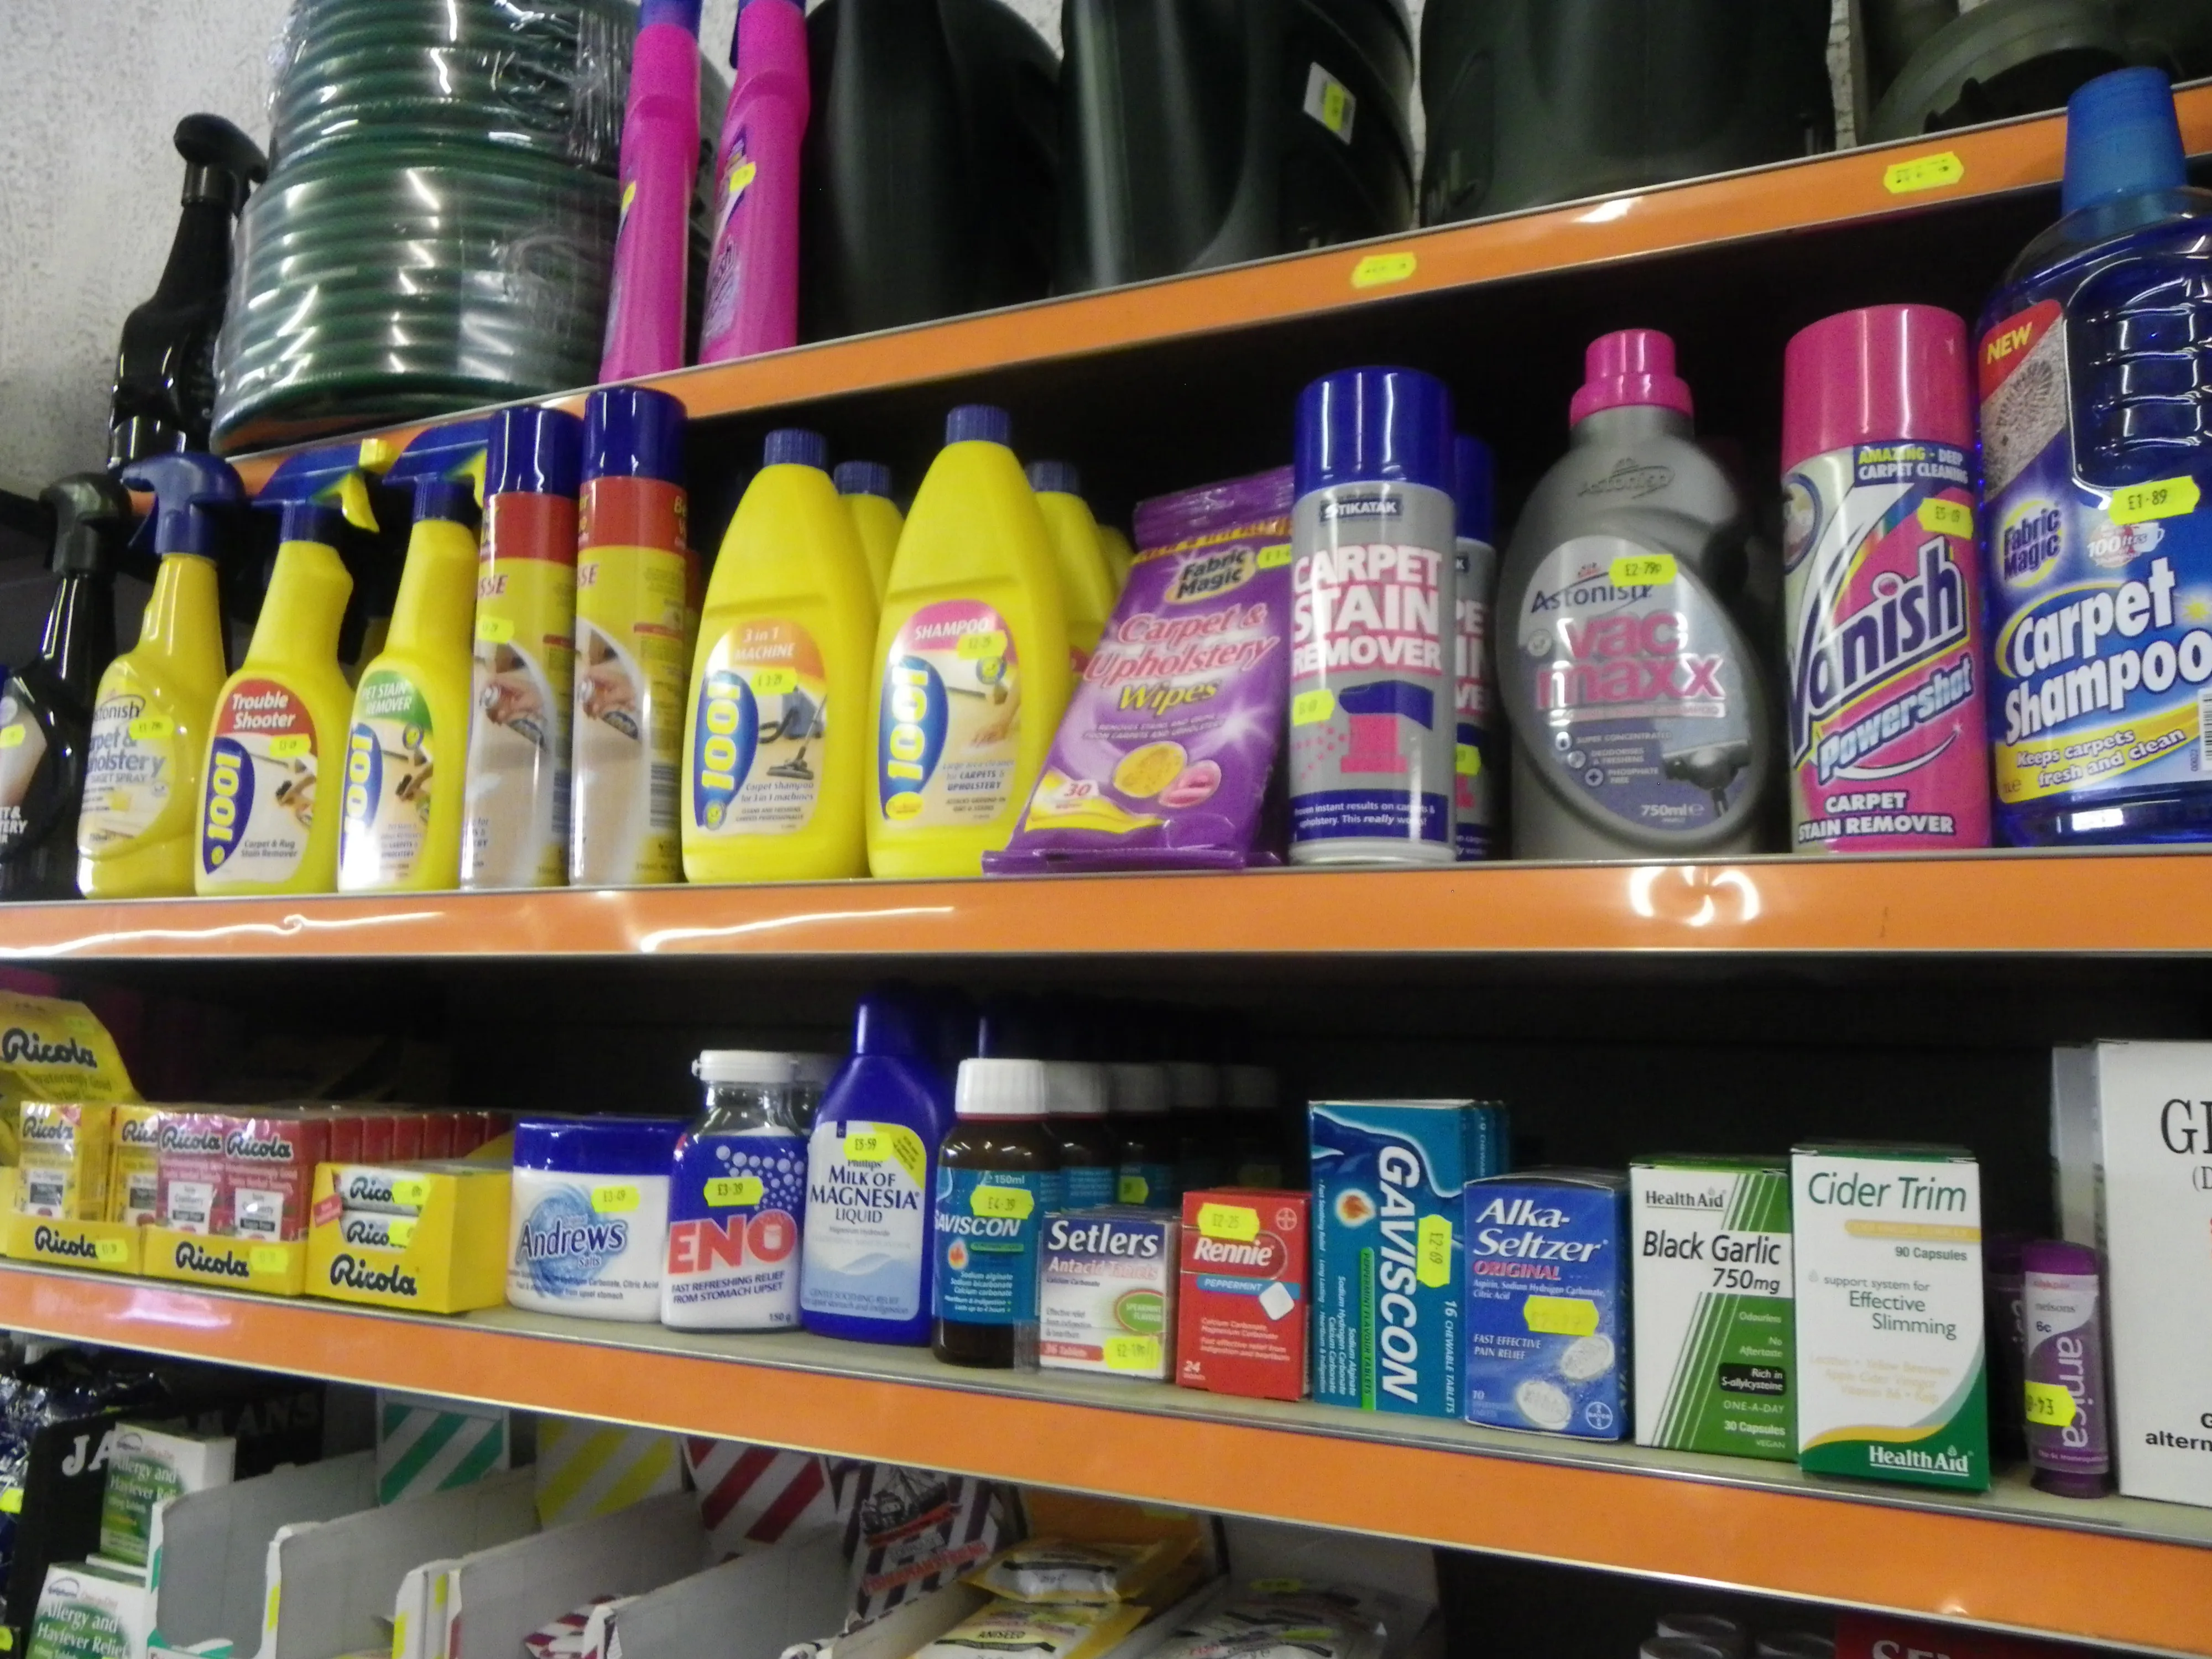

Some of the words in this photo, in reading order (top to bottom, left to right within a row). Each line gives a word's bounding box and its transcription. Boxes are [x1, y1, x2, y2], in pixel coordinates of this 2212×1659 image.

[1986, 321, 2033, 364] NEW
[1858, 446, 1925, 465] AMAZING
[1938, 447, 1964, 467] DEEP
[1858, 462, 1914, 481] CARPET
[1916, 462, 1969, 485] CLEANING
[1325, 499, 1397, 515] STIKATAK
[2004, 507, 2061, 550] Fabric
[2003, 534, 2060, 581] Magic
[2086, 536, 2121, 559] 100
[1181, 547, 1244, 580] Fabric
[1294, 546, 1442, 588] CARPET
[1176, 567, 1243, 599] Magic
[1294, 583, 1438, 640] STAIN
[2013, 556, 2176, 677] Carpet
[743, 629, 753, 643] 3
[754, 630, 769, 641] in
[771, 627, 780, 640] 1
[915, 618, 990, 640] SHAMPOO
[1118, 606, 1237, 647] Carpet
[1241, 603, 1267, 628] &
[1557, 611, 1688, 659] vac
[735, 643, 794, 661] MACHINE
[1293, 636, 1442, 671] REMOVER
[1789, 536, 1968, 760] Vanish
[1083, 636, 1280, 688] Upholstery
[361, 686, 378, 701] PET
[1536, 654, 1726, 709] maxx
[2005, 628, 2212, 745] Shampoo
[232, 692, 288, 710] Trouble
[367, 697, 413, 717] REMOVER
[1118, 680, 1218, 715] Wipes
[234, 709, 295, 729] Shooter
[887, 667, 928, 781] 1001
[1817, 655, 1974, 786] Powershot
[701, 683, 741, 791] 1001
[1576, 735, 1602, 744] SUPER
[1605, 732, 1673, 742] CONCENTRATED
[2017, 747, 2060, 768] Keeps
[2064, 729, 2135, 760] carpets
[1591, 747, 1645, 757] DEODORISES
[1602, 755, 1645, 764] FRESHENS
[2038, 763, 2083, 788] fresh
[2087, 749, 2125, 774] and
[2128, 728, 2187, 760] clean
[960, 770, 997, 780] CARPETS
[1608, 766, 1659, 776] PHOSPHATE
[1610, 775, 1630, 784] FREE
[208, 752, 241, 843] 1001
[746, 782, 772, 792] Carpet
[774, 792, 813, 801] machines
[947, 781, 1001, 791] UPHOLSTERY
[1063, 781, 1091, 797] 30
[1315, 803, 1344, 813] instant
[1346, 801, 1379, 811] results
[1641, 804, 1687, 817] 750ml
[1824, 791, 1908, 813] CARPET
[1342, 815, 1361, 823] This
[1363, 814, 1394, 826] really
[1799, 817, 1841, 841] STAIN
[1844, 814, 1954, 836] REMOVER
[241, 848, 263, 858] Stain
[263, 848, 299, 858] Remover
[244, 839, 270, 849] Carpet
[279, 839, 295, 850] Rug
[2, 1027, 98, 1069] Ricola
[23, 1115, 74, 1139] Ricola
[162, 1125, 221, 1151] Ricola
[226, 1131, 292, 1158] Ricola
[873, 1172, 896, 1187] OF
[995, 1175, 1025, 1185] 150ml
[1808, 1171, 1891, 1208] Cider
[1898, 1176, 1968, 1213] Trim
[836, 1208, 883, 1225] LIQUID
[1474, 1197, 1571, 1229] Alka-
[34, 1225, 98, 1259] Ricola
[516, 1219, 625, 1264] Andrews
[667, 1209, 797, 1274] ENO
[1047, 1219, 1159, 1257] Setlers
[1473, 1228, 1602, 1262] Seltzer
[1642, 1229, 1704, 1260] Black
[1712, 1234, 1781, 1265] Garlic
[175, 1239, 250, 1278] Ricola
[1193, 1237, 1274, 1266] Rennie
[1895, 1246, 1910, 1258] 90
[1913, 1247, 1968, 1261] Capsules
[330, 1253, 418, 1296] Ricola
[1048, 1256, 1105, 1274] Antacid
[1378, 1145, 1421, 1404] GAVISCON
[1473, 1260, 1562, 1281] ORIGINAL
[672, 1282, 690, 1293] FAST
[692, 1275, 753, 1292] REFRESHING
[754, 1270, 786, 1283] RELIEF
[672, 1293, 699, 1304] FROM
[700, 1286, 752, 1302] STOMACH
[753, 1281, 784, 1295] UPSET
[1204, 1278, 1262, 1291] PEPPERMINT
[1337, 1275, 1347, 1308] Sodium
[1363, 1253, 1373, 1309] PEPPERMINT
[1502, 1281, 1528, 1291] Sodium
[1529, 1283, 1564, 1295] Hydrogen
[1712, 1267, 1781, 1295] 750mg
[1824, 1276, 1868, 1288] support
[1871, 1279, 1910, 1292] system
[1912, 1280, 1931, 1292] for
[1473, 1289, 1493, 1298] Citric
[1495, 1291, 1510, 1300] Acid
[1849, 1290, 1927, 1312] Effective
[1444, 1300, 1458, 1318] 16
[1739, 1311, 1782, 1324] Odourless
[2035, 1302, 2076, 1313] nelsons
[1328, 1316, 1337, 1350] Calcium
[1337, 1308, 1346, 1352] Hydrogen
[1363, 1311, 1373, 1357] FLAVOUR
[1872, 1312, 1958, 1341] Slimming
[2036, 1321, 2052, 1333] 6c
[1348, 1328, 1357, 1354] Sodium
[1444, 1320, 1455, 1371] CHEWABLE
[1474, 1333, 1494, 1344] FAST
[1496, 1335, 1542, 1349] EFFECTIVE
[1474, 1346, 1495, 1357] PAIN
[1498, 1349, 1526, 1360] RELIEF
[1739, 1345, 1783, 1358] Aftertaste
[1767, 1336, 1783, 1346] No
[1183, 1360, 1201, 1373] 24
[1328, 1350, 1337, 1394] Carbonate
[1338, 1352, 1347, 1396] Carbonate
[1347, 1355, 1357, 1397] Alginate
[1363, 1357, 1373, 1395] TABLETS
[1751, 1368, 1772, 1379] Rich
[1774, 1370, 1783, 1379] in
[1445, 1374, 1455, 1414] TABLETS
[1723, 1400, 1785, 1414] ONE-A-DAY
[1724, 1420, 1738, 1431] 30
[1739, 1421, 1786, 1436] Capsules
[1755, 1439, 1786, 1449] VEGAN
[154, 1468, 176, 1484] and
[43, 1600, 90, 1631] Allergy
[91, 1615, 119, 1634] and
[36, 1622, 90, 1647] Hayfever
[92, 1636, 128, 1658] Relief
